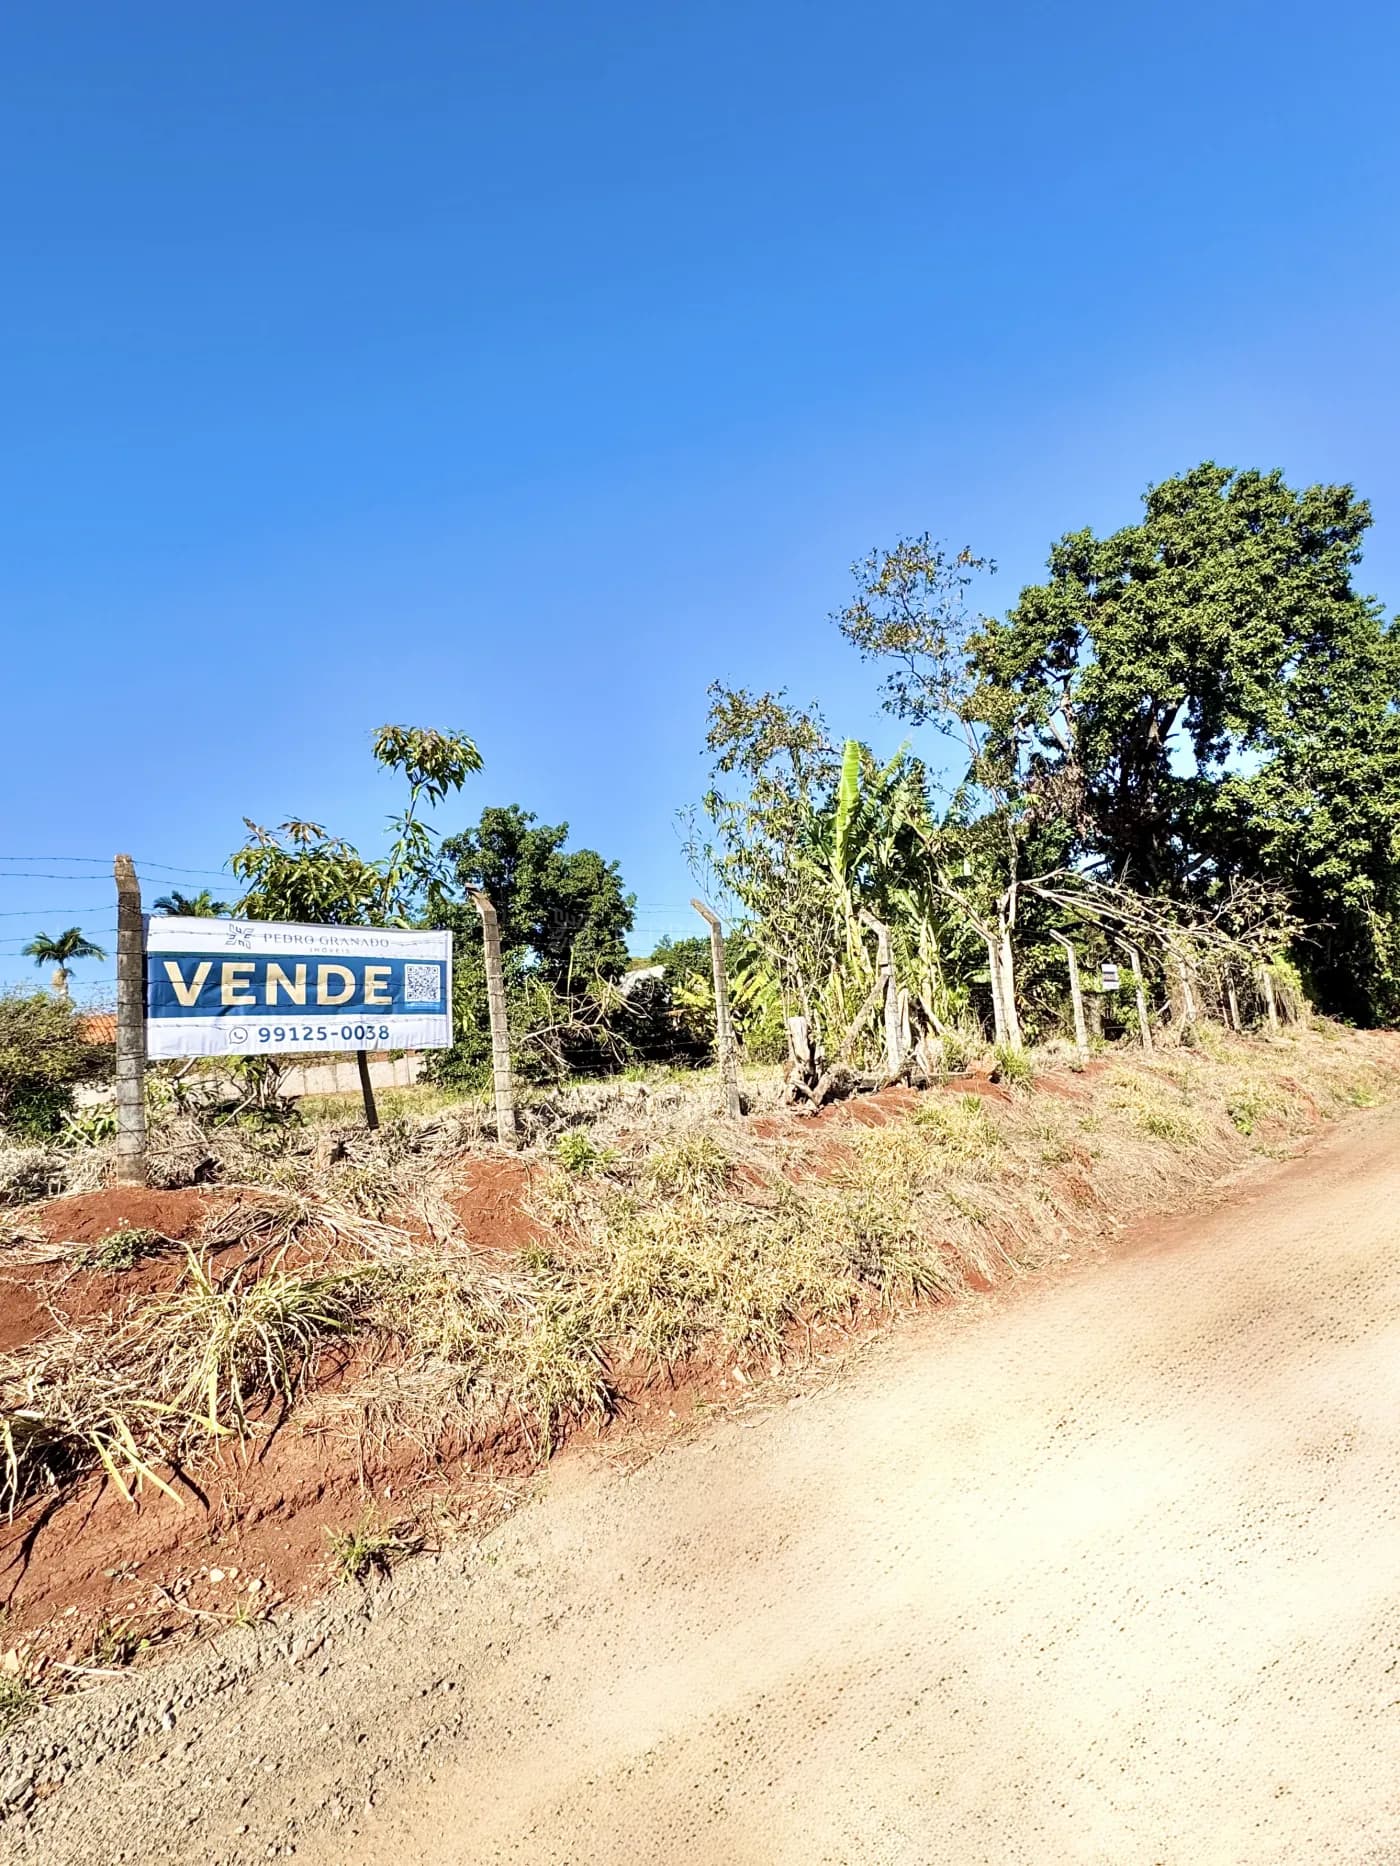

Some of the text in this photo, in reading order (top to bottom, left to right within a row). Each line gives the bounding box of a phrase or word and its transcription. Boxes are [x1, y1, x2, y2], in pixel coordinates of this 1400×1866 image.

[263, 932, 390, 948] PEDRO GRANADO
[163, 961, 393, 1007] VENDE
[258, 1025, 390, 1043] 99125-0038
